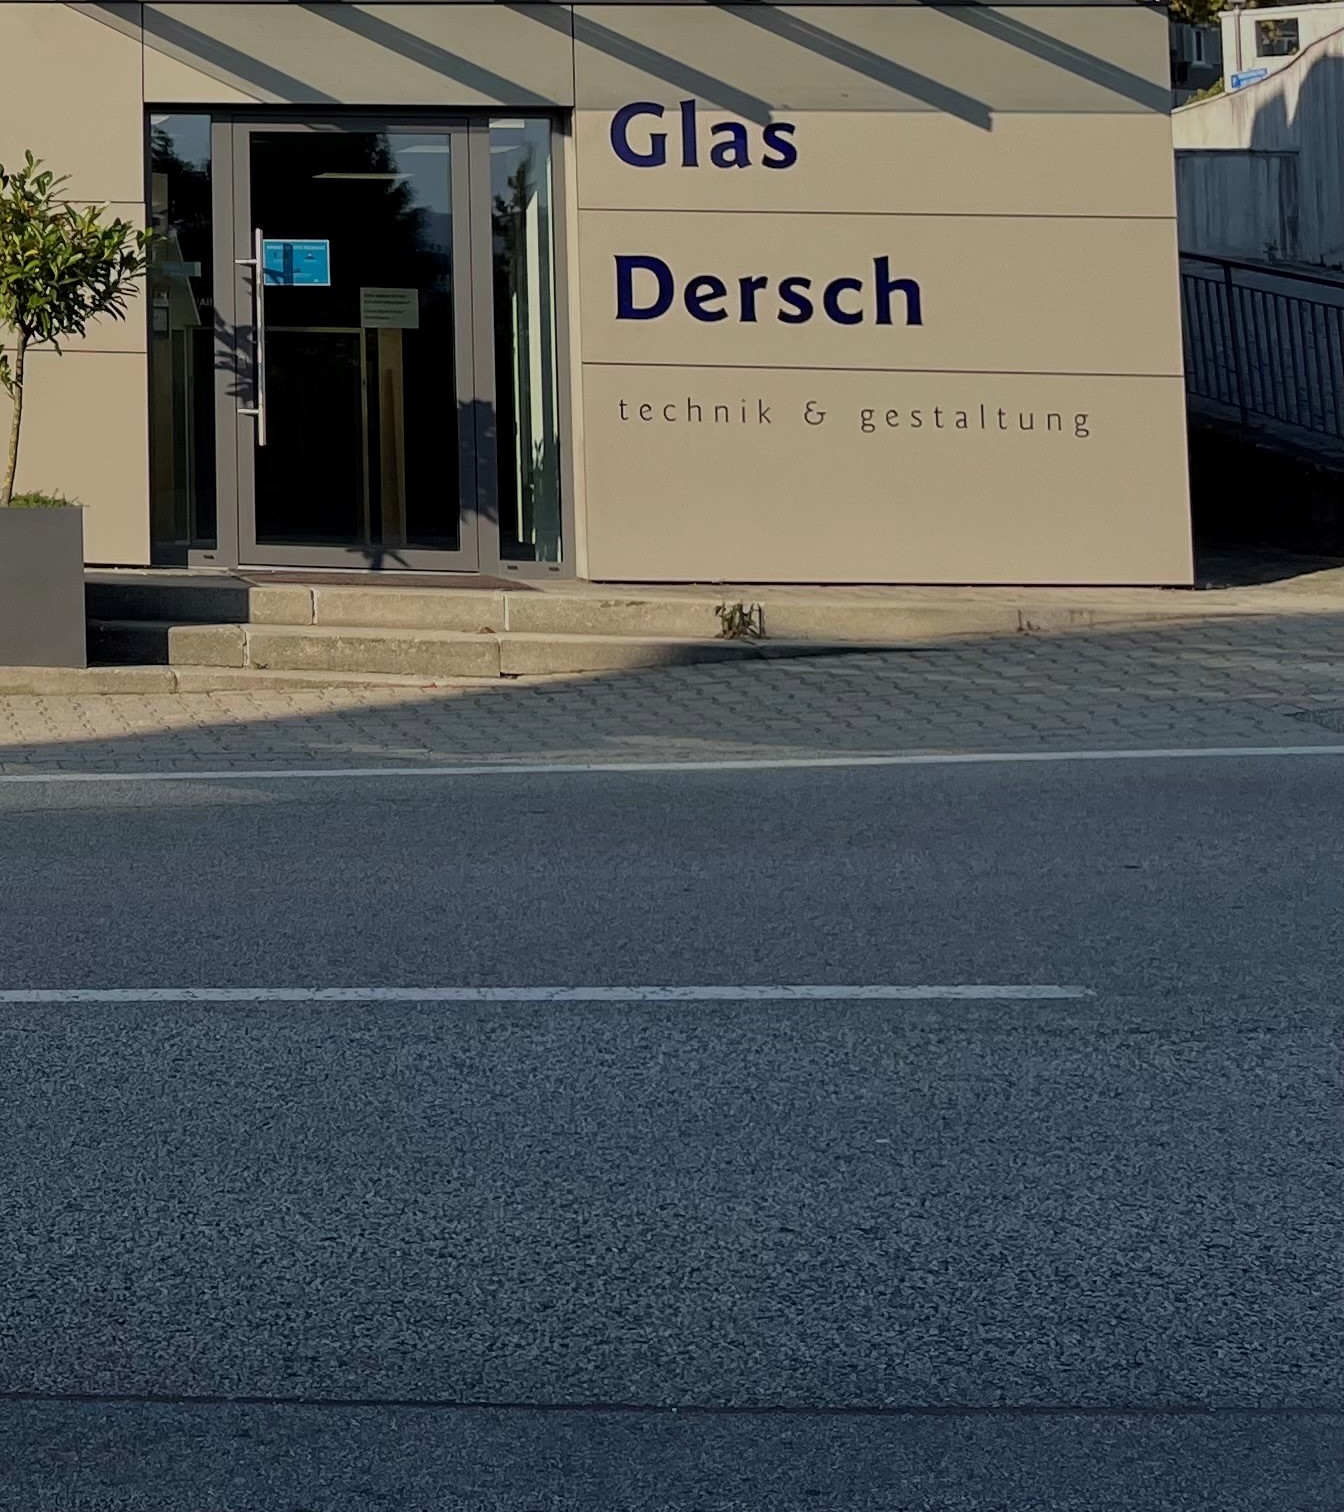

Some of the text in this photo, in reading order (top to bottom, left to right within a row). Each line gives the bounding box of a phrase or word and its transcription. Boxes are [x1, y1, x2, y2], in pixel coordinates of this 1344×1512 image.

[610, 98, 798, 169] Glas
[614, 254, 923, 326] Dersch
[618, 397, 1091, 439] technik & gestaltung
